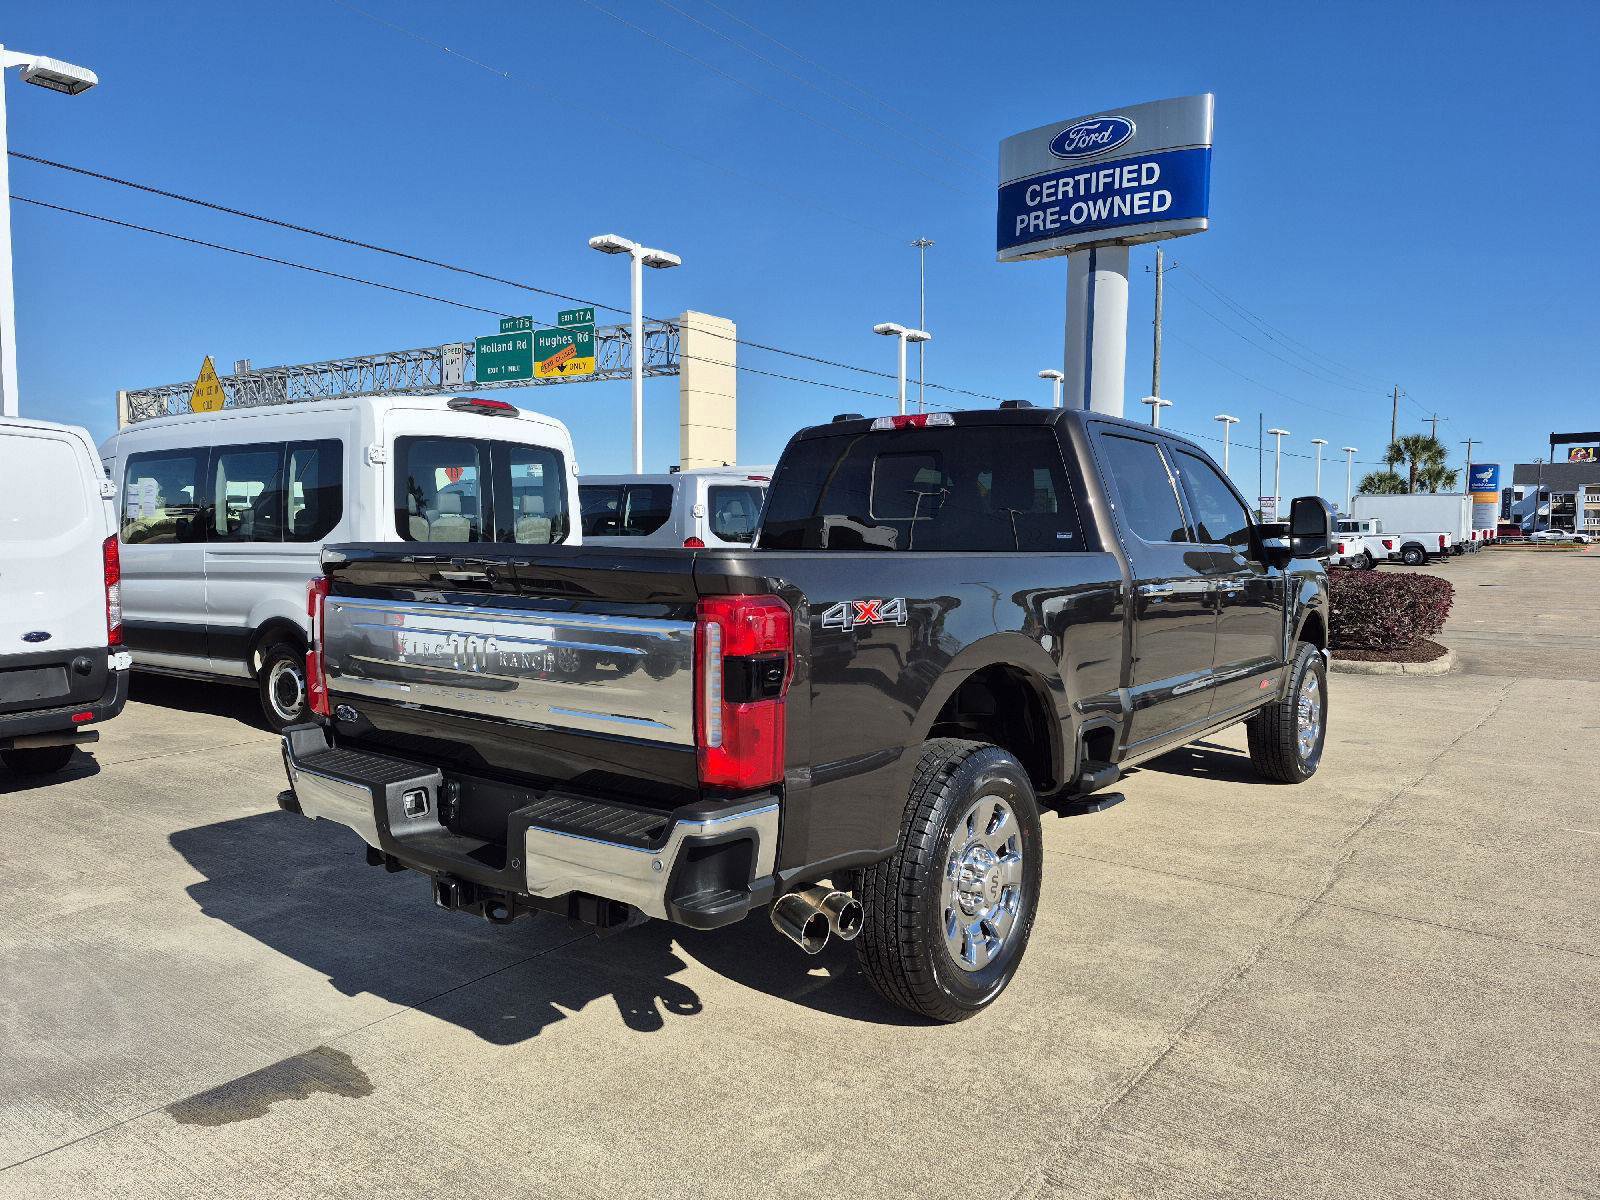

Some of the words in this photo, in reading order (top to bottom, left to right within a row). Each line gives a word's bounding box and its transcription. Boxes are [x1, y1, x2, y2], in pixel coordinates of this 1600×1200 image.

[1064, 122, 1114, 149] Ford
[1025, 162, 1161, 207] CERTIFIED
[1015, 189, 1173, 236] PRE-OWNED
[502, 321, 513, 329] EXIT
[561, 314, 573, 322] EXIT
[480, 340, 513, 354] Holland
[516, 339, 527, 350] Rd
[539, 334, 573, 348] Hughes
[577, 331, 589, 343] Rd
[443, 347, 462, 355] SPEED
[487, 366, 499, 374] EXIT
[569, 362, 587, 370] ONLY
[500, 651, 555, 673] RANCH
